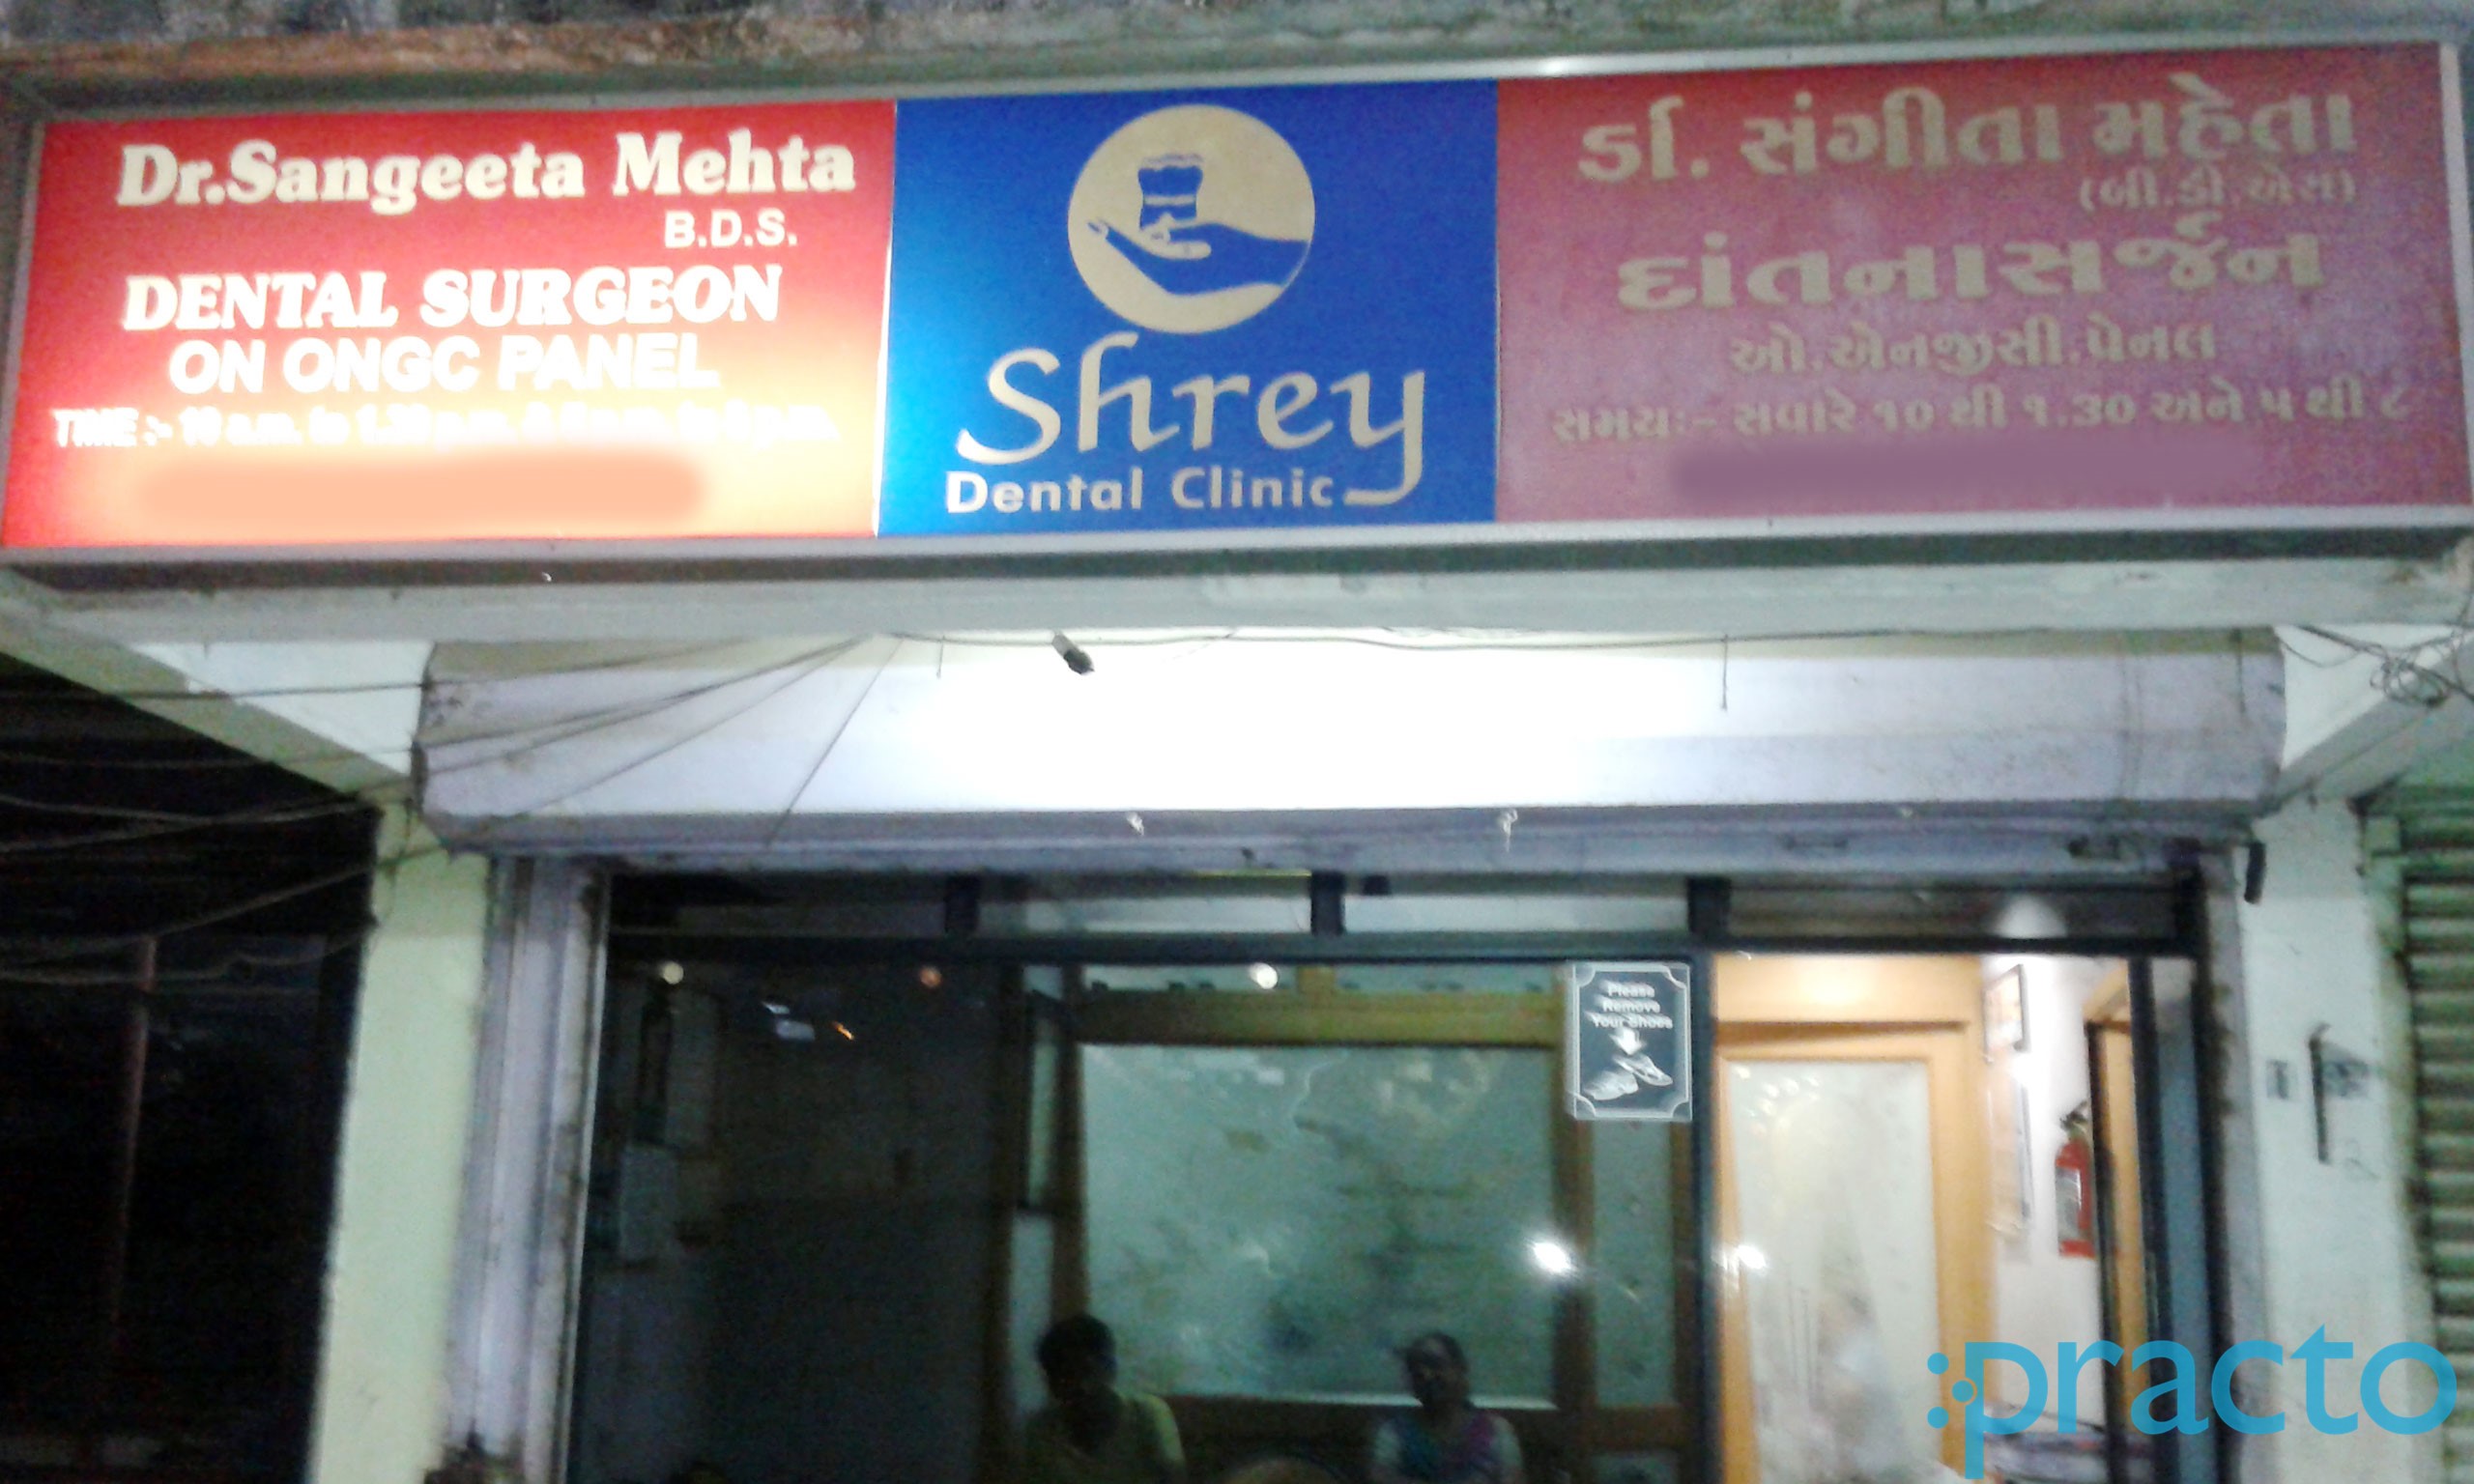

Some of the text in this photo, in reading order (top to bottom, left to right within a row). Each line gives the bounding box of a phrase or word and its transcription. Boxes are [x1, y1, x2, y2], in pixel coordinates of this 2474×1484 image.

[1740, 86, 2065, 177] સંગીતા
[2092, 71, 2358, 160] મહેતા
[116, 128, 855, 214] Dr.Sangeeta Mehta
[664, 209, 798, 248] B.D.S.
[123, 264, 783, 331] DENTAL SURGEON
[168, 331, 721, 394] ON ONGC PANEL
[955, 331, 1425, 506] Shrey
[945, 466, 1334, 513] Dental Clinic
[1599, 996, 1660, 1013] Remove
